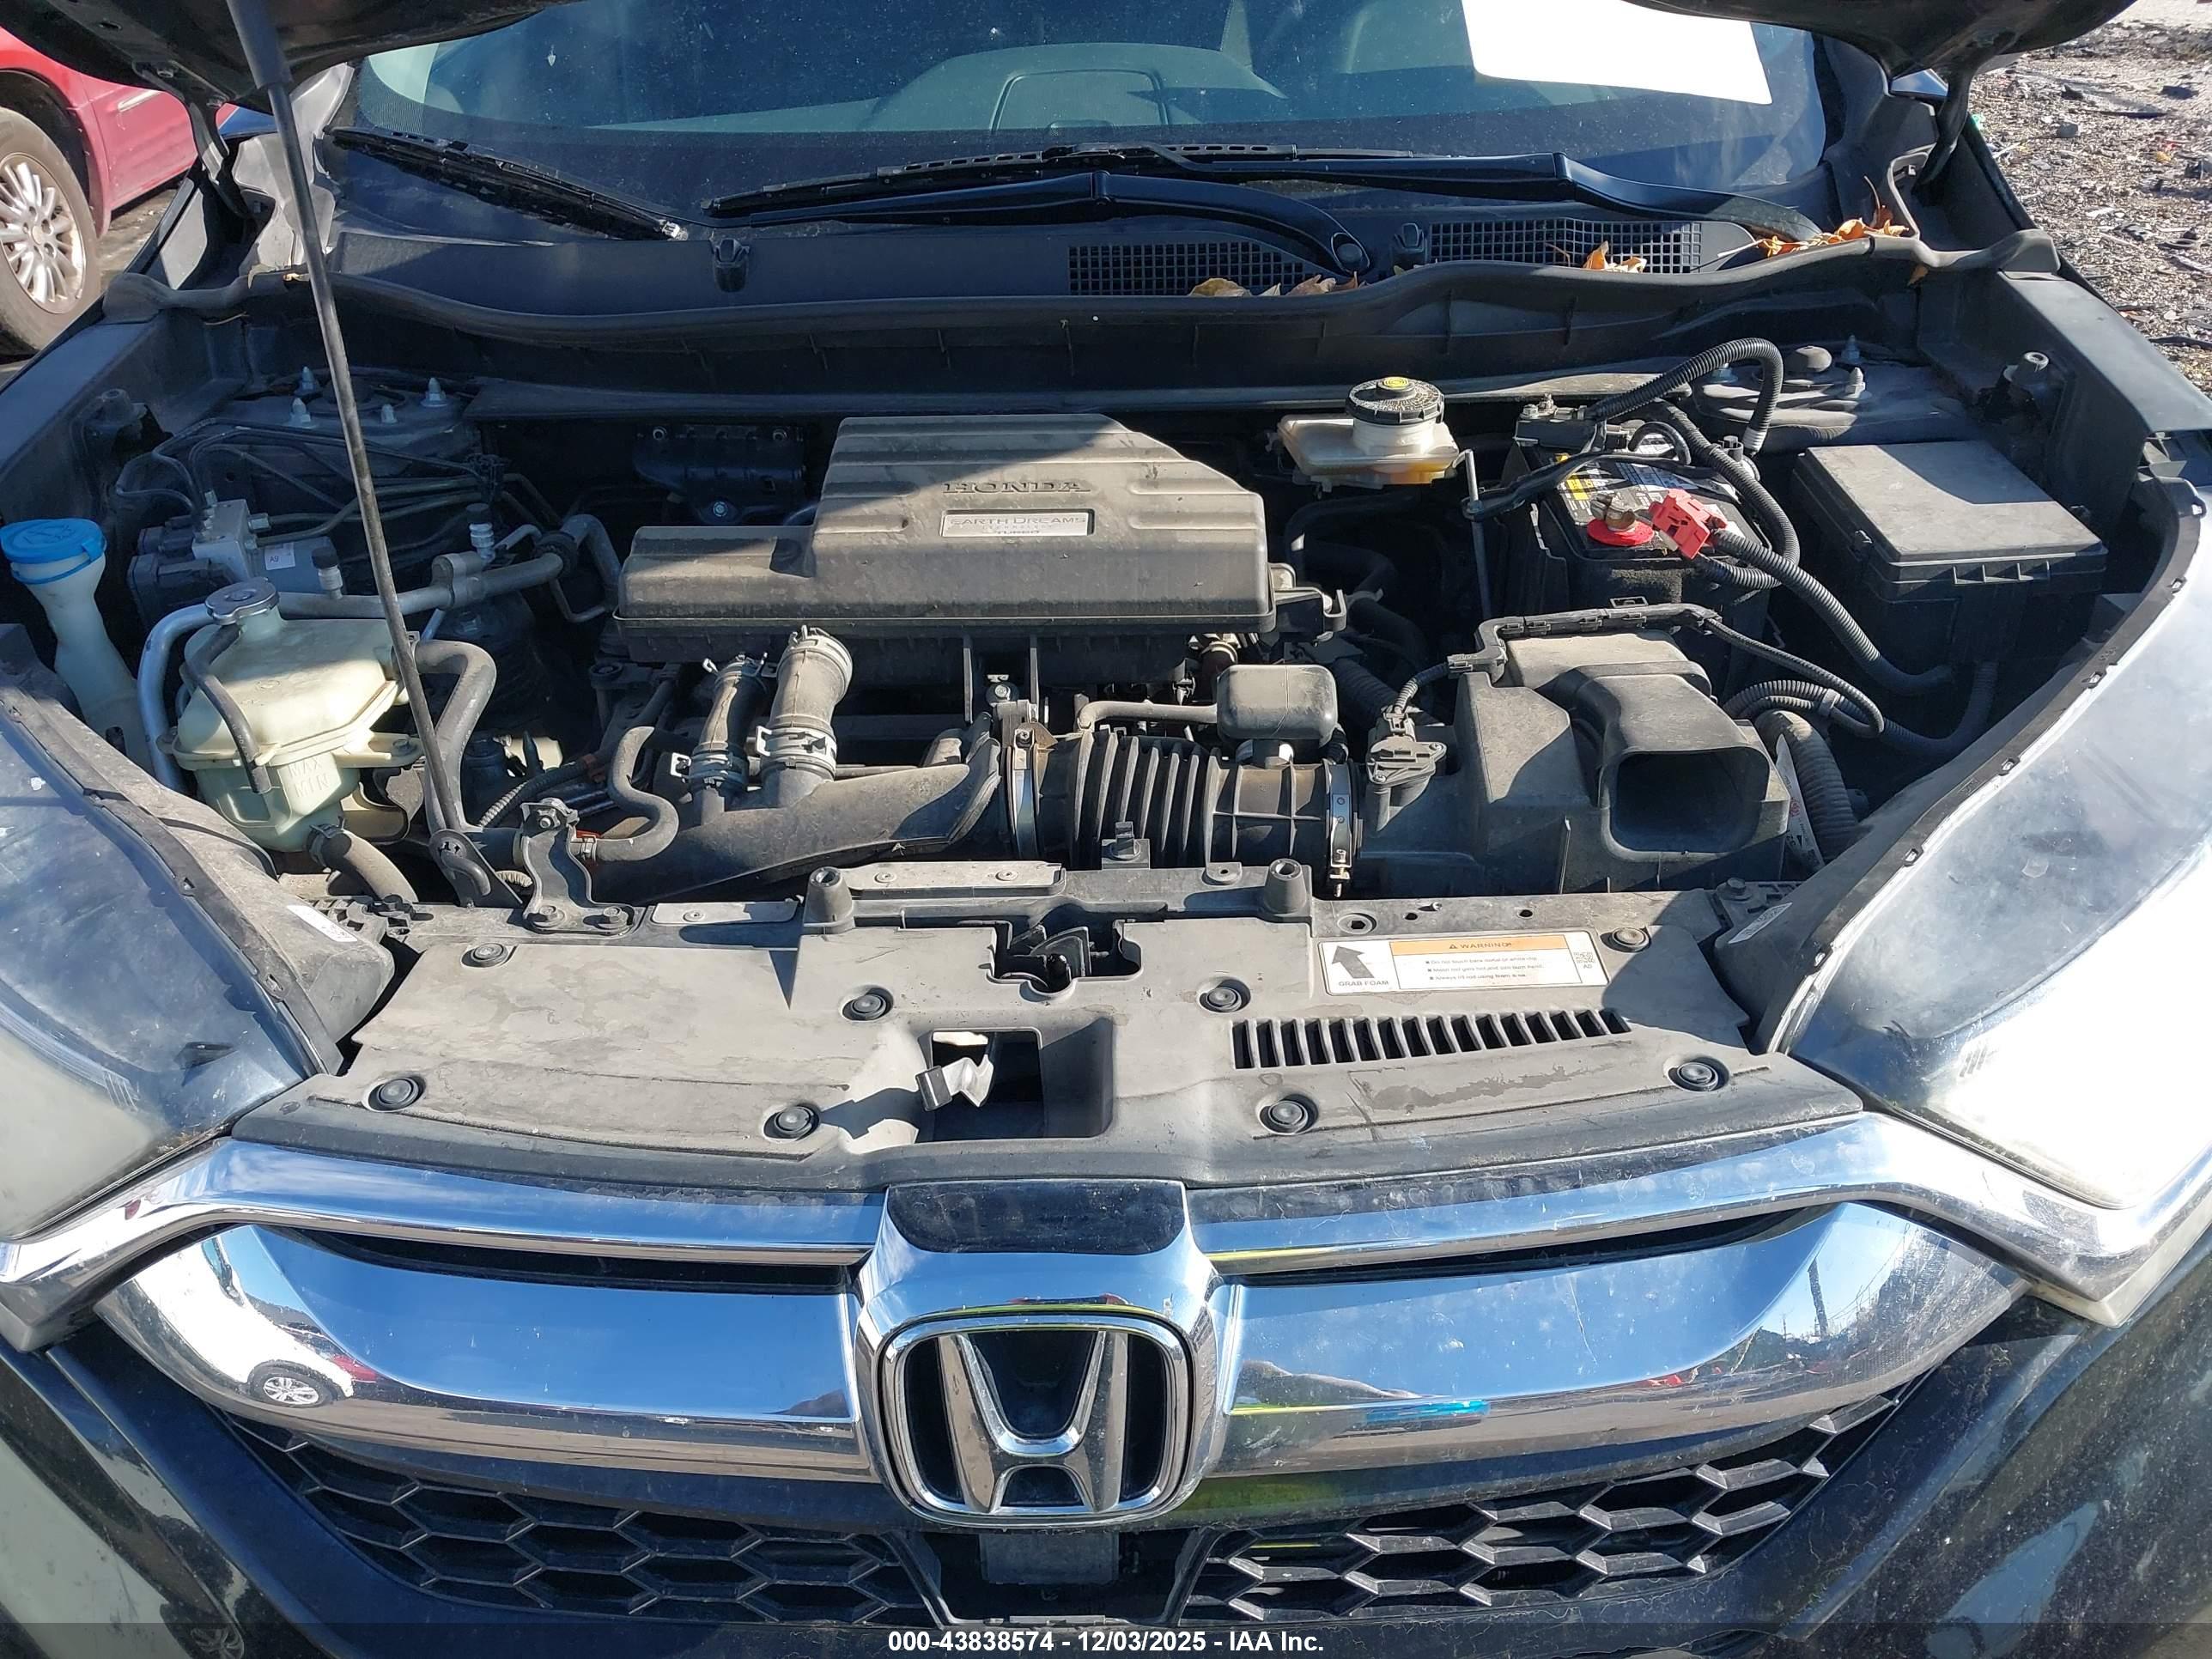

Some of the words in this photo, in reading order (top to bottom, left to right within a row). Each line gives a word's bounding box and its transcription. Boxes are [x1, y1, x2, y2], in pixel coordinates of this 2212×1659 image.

[943, 481, 1091, 494] HONDA
[288, 756, 323, 779] MAX
[294, 773, 330, 798] MIN
